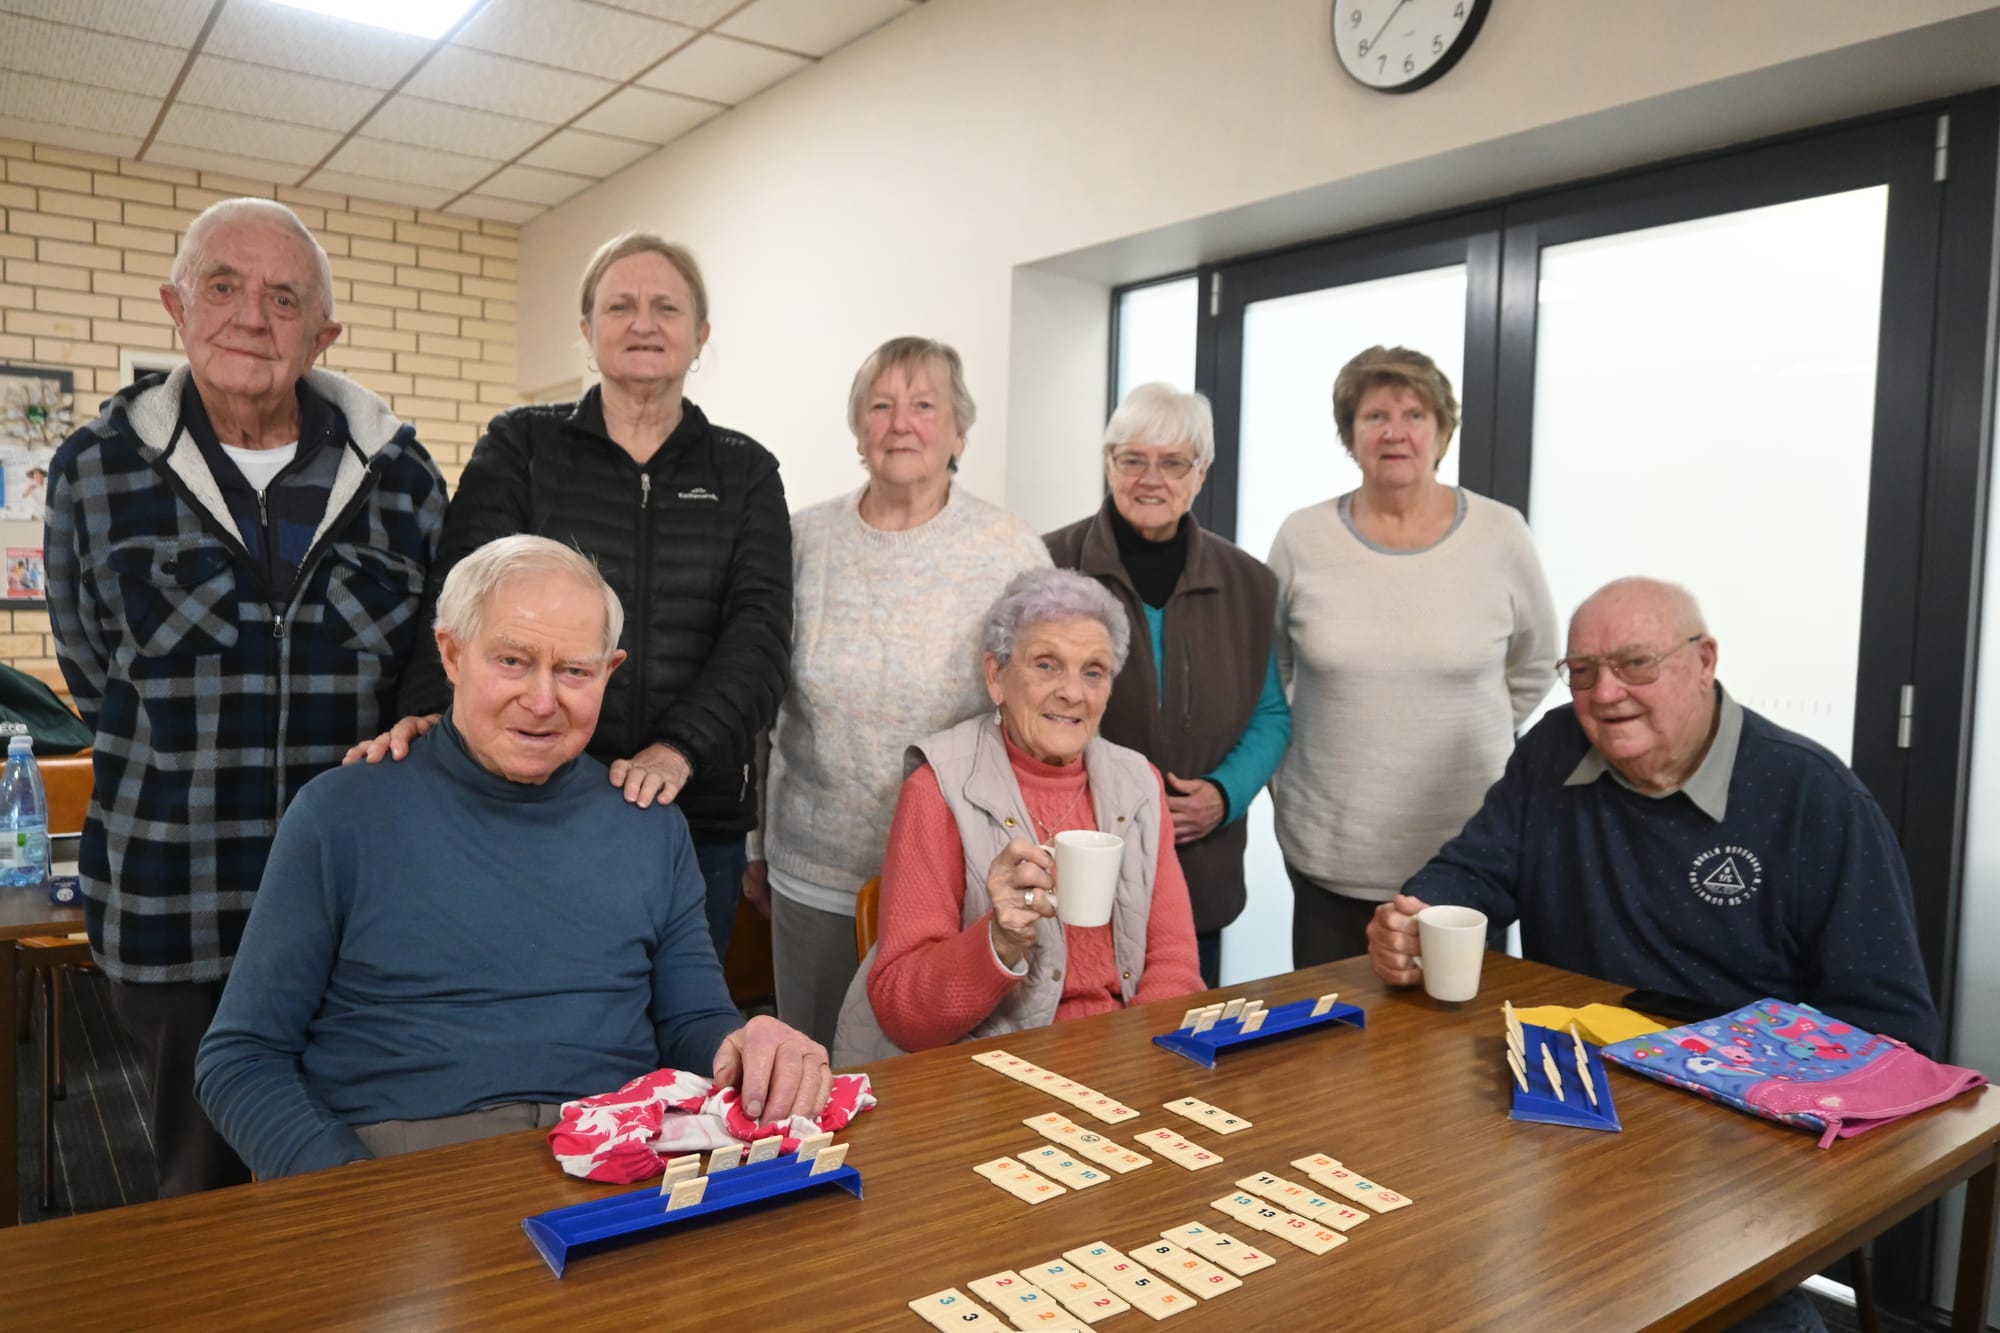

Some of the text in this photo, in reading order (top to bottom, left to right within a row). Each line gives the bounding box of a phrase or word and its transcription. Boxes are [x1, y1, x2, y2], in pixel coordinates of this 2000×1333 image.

[1351, 9, 1362, 29] 9
[1453, 2, 1464, 20] 4
[1358, 38, 1368, 58] 8
[1432, 34, 1443, 55] 5
[1377, 54, 1388, 74] 7
[1403, 54, 1415, 73] 6
[1224, 1118, 1238, 1126] 6
[1059, 1126, 1077, 1134] 10
[1101, 1145, 1119, 1154] 12
[1121, 1154, 1139, 1164] 13
[1154, 1131, 1211, 1161] 10 11 12
[1059, 1160, 1074, 1168] 9
[1079, 1170, 1098, 1180] 10
[1312, 1157, 1374, 1191] 12 12 12
[1257, 1176, 1357, 1219] 11 11 11 11
[1233, 1195, 1334, 1242] 13 13 13 13
[1186, 1227, 1260, 1261] 7 7 7
[1090, 1247, 1177, 1304] 5 5 5 5
[1155, 1246, 1225, 1284] 8 8 8
[995, 1278, 1057, 1321] 2 2 2
[1046, 1265, 1111, 1308] 2 2 2
[939, 1296, 980, 1322] 3 3
